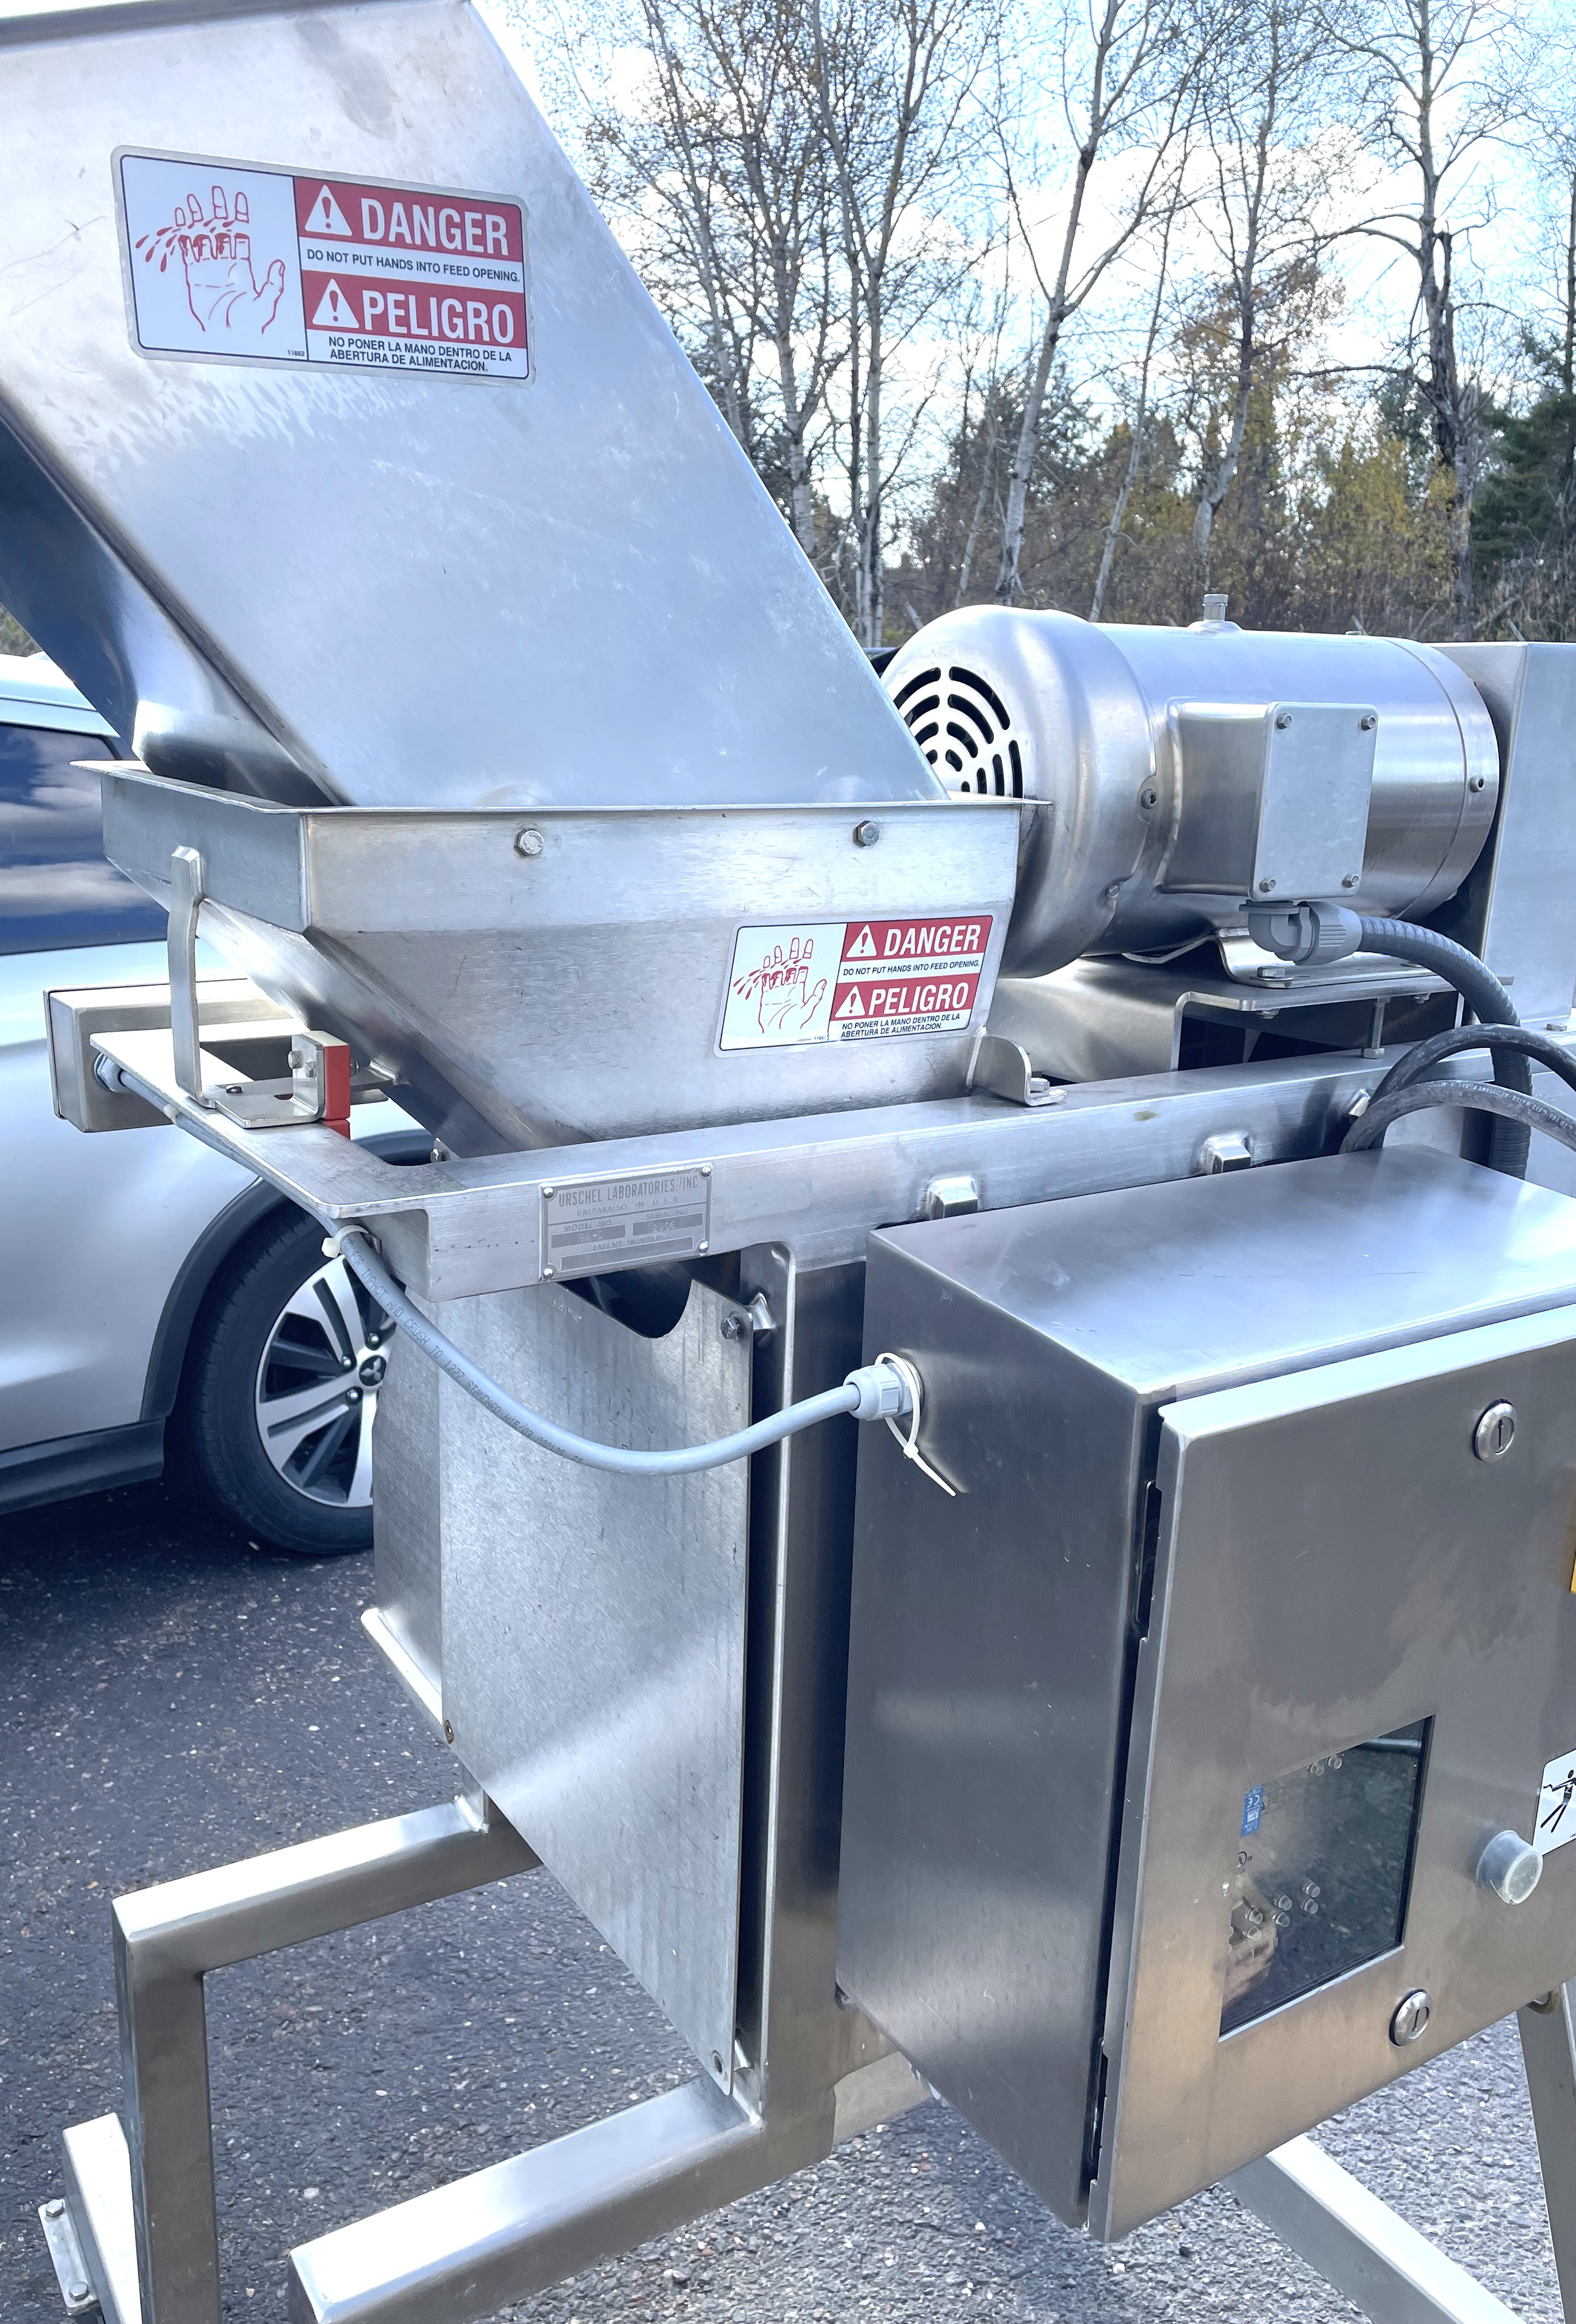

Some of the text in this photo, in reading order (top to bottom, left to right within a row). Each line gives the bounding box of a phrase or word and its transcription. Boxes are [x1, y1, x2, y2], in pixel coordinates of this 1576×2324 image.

[361, 198, 509, 256] DANGER
[307, 249, 520, 282] DO NOT PUT HANDS INTO FEED OPENING.
[362, 290, 514, 344] PELIGRO
[328, 337, 512, 362] NO PONER LA MANO DENTRO DE LA
[330, 349, 488, 372] ABERTURA DE ALIMENTACION.
[883, 924, 981, 956] DANGER
[887, 965, 911, 973] HANDS
[930, 962, 948, 970] FEED
[950, 960, 980, 968] OPENING.
[868, 982, 969, 1016] PELIGRO
[841, 1028, 878, 1038] ABERTURA
[891, 1023, 942, 1033] ALIMENTACION.
[854, 1021, 878, 1029] PONER
[890, 1018, 911, 1026] MANO
[913, 1015, 940, 1024] DENTRO
[558, 1188, 602, 1207] URSCHEL
[577, 1203, 627, 1216] VALPARAISO
[646, 1210, 670, 1220] SERIAL
[564, 1221, 592, 1232] MODEL
[592, 1234, 666, 1251] PATENT NUMBERS
[361, 1267, 388, 1299] IMPACT
[387, 1300, 405, 1318] AND
[405, 1319, 431, 1346] CRUSH
[431, 1345, 444, 1359] TO
[444, 1360, 466, 1379] 1277
[465, 1380, 502, 1413] STANDARD
